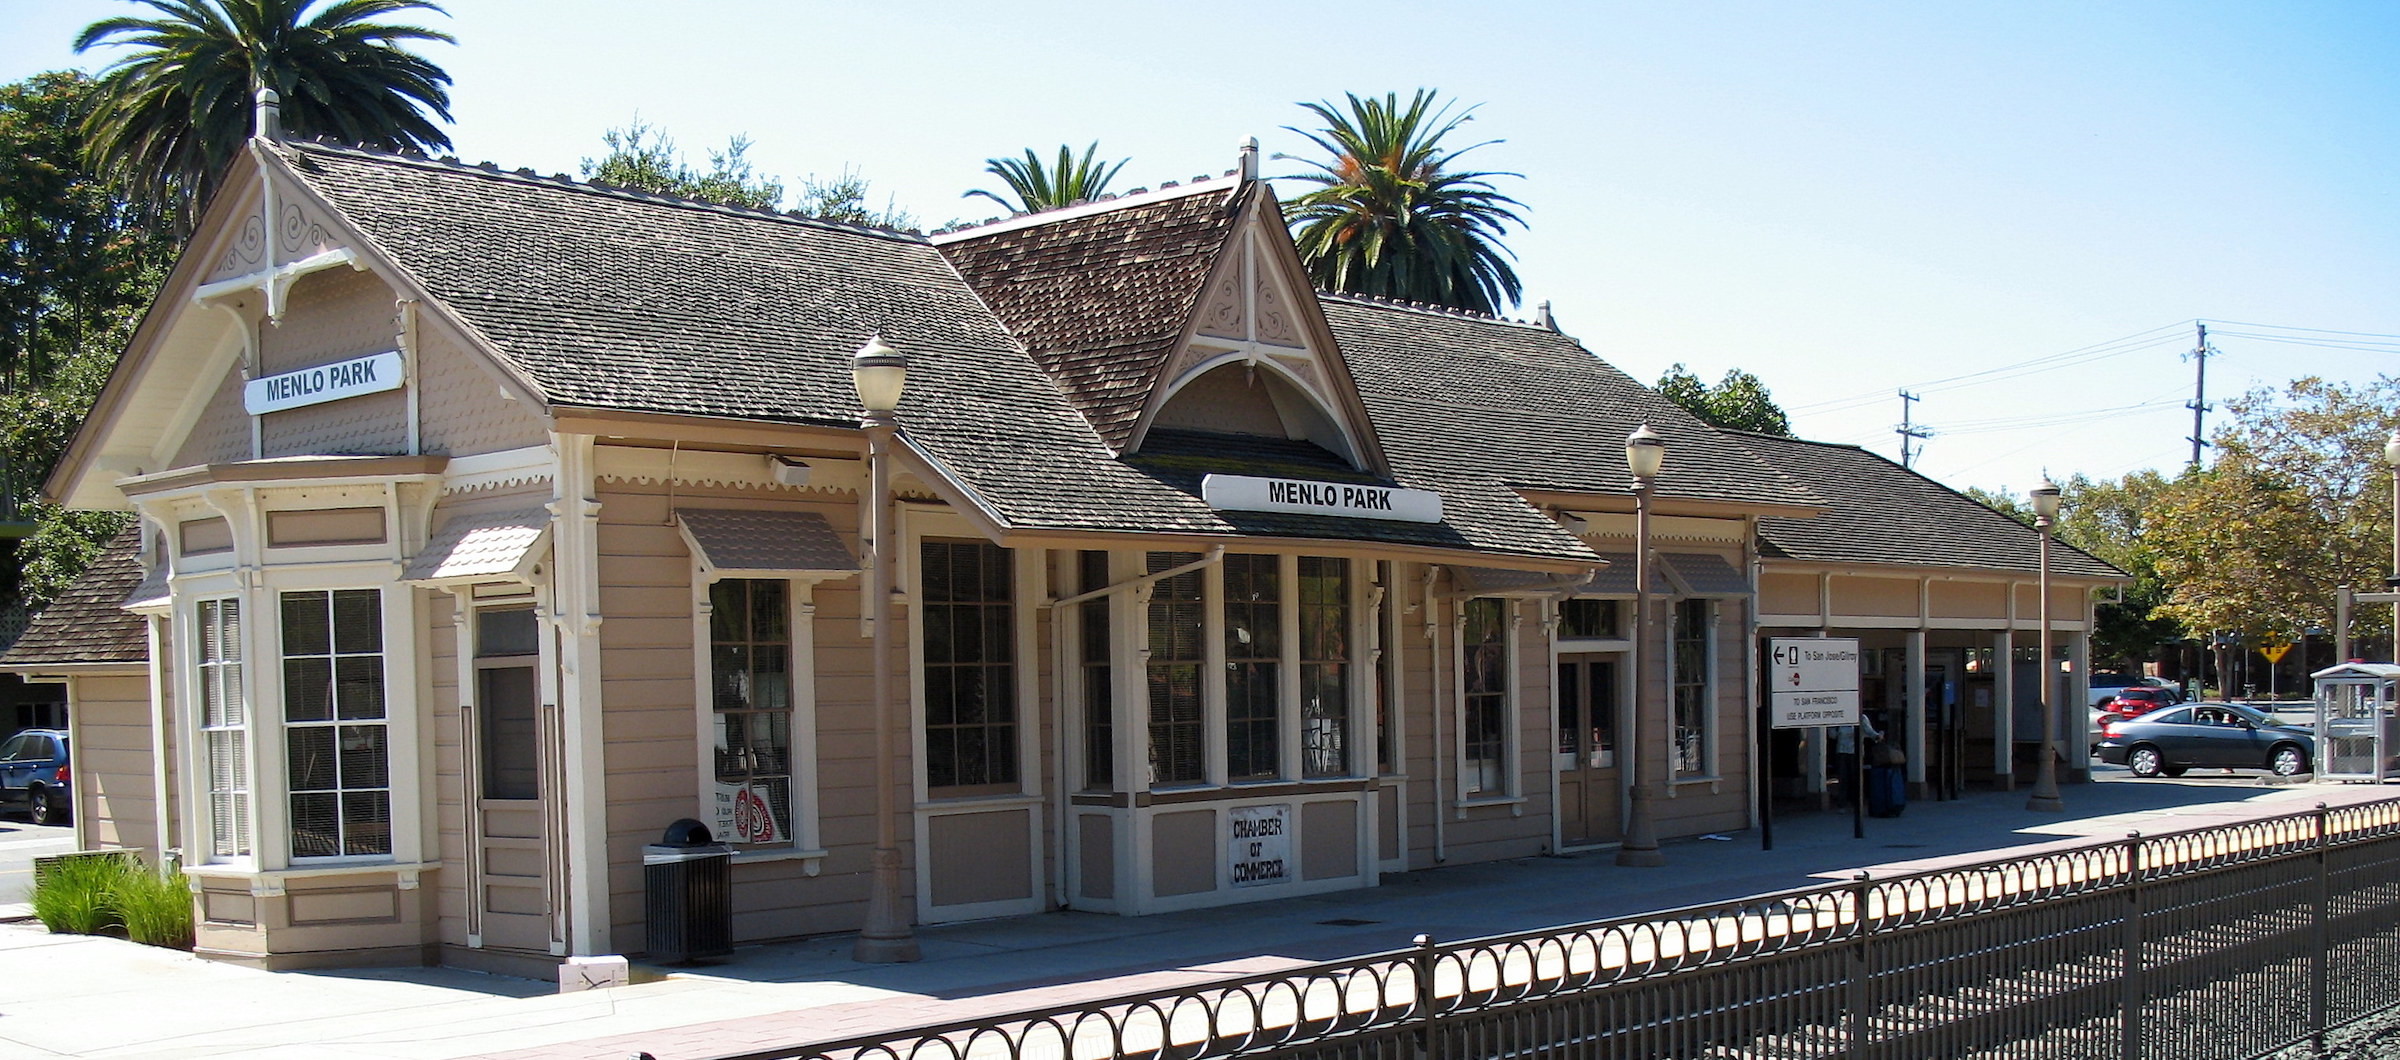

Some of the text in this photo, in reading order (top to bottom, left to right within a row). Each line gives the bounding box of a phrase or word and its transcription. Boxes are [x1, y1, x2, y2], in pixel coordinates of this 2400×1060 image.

[266, 359, 376, 402] MENLO PARK
[1269, 481, 1392, 511] MENLO PARK
[1804, 650, 1811, 661] To
[1812, 650, 1824, 661] San
[1793, 696, 1838, 706] TO SAN FRANCISCO
[1786, 710, 1845, 720] USE PLATFORM OPPOSITE
[1233, 817, 1283, 839] CHAMBER
[1250, 842, 1263, 858] OF
[1234, 859, 1284, 884] COMMERCE
